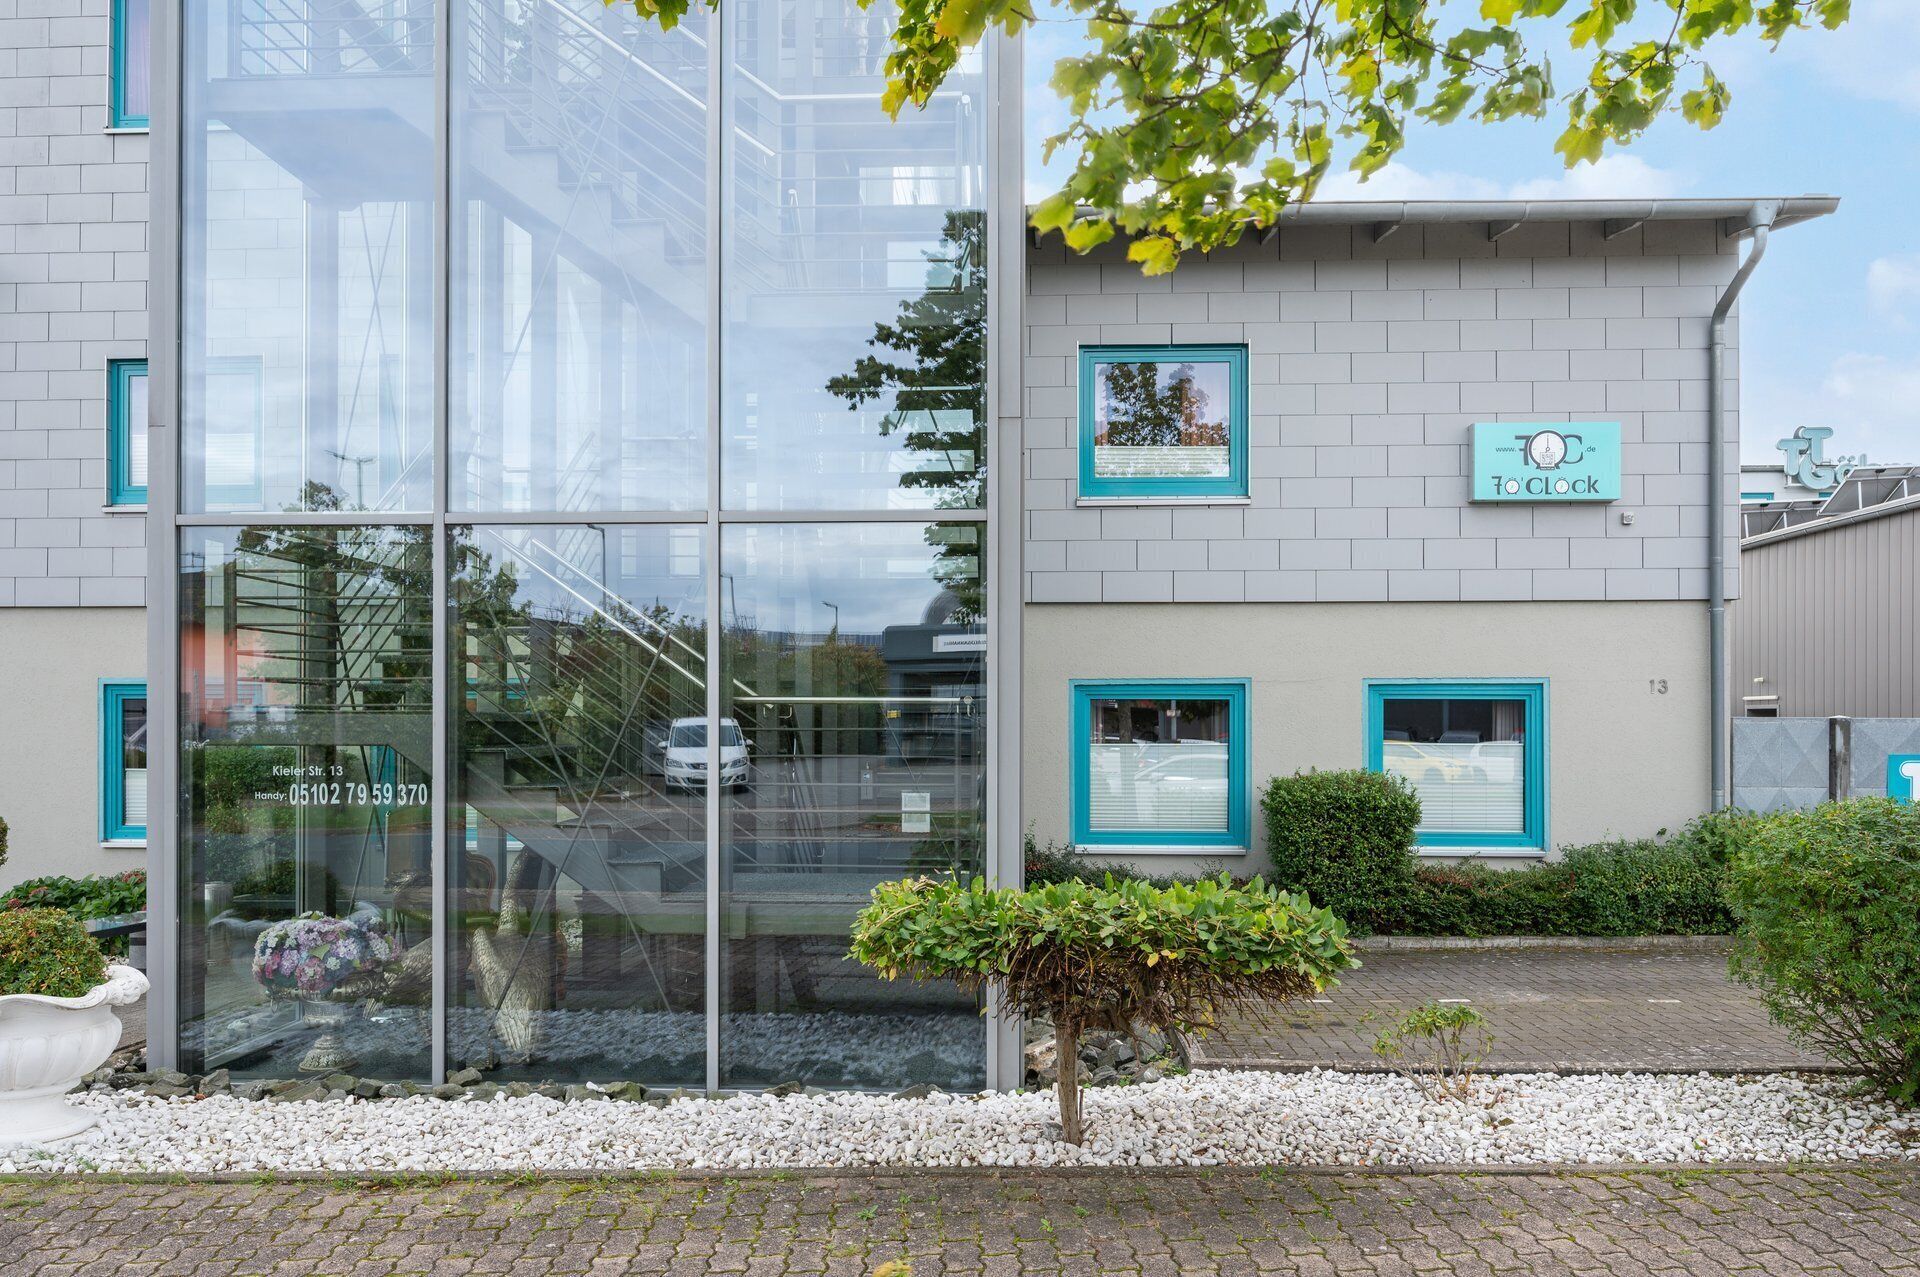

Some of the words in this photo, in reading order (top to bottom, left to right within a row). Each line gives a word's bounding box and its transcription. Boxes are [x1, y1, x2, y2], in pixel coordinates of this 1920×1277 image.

[1649, 679, 1669, 695] 13
[272, 765, 305, 776] Kieler
[308, 765, 326, 776] Str.
[330, 765, 344, 776] 13
[254, 791, 287, 801] Handy:
[289, 783, 340, 805] 05102
[346, 782, 367, 805] 79
[372, 782, 393, 805] 59
[397, 783, 428, 805] 370
